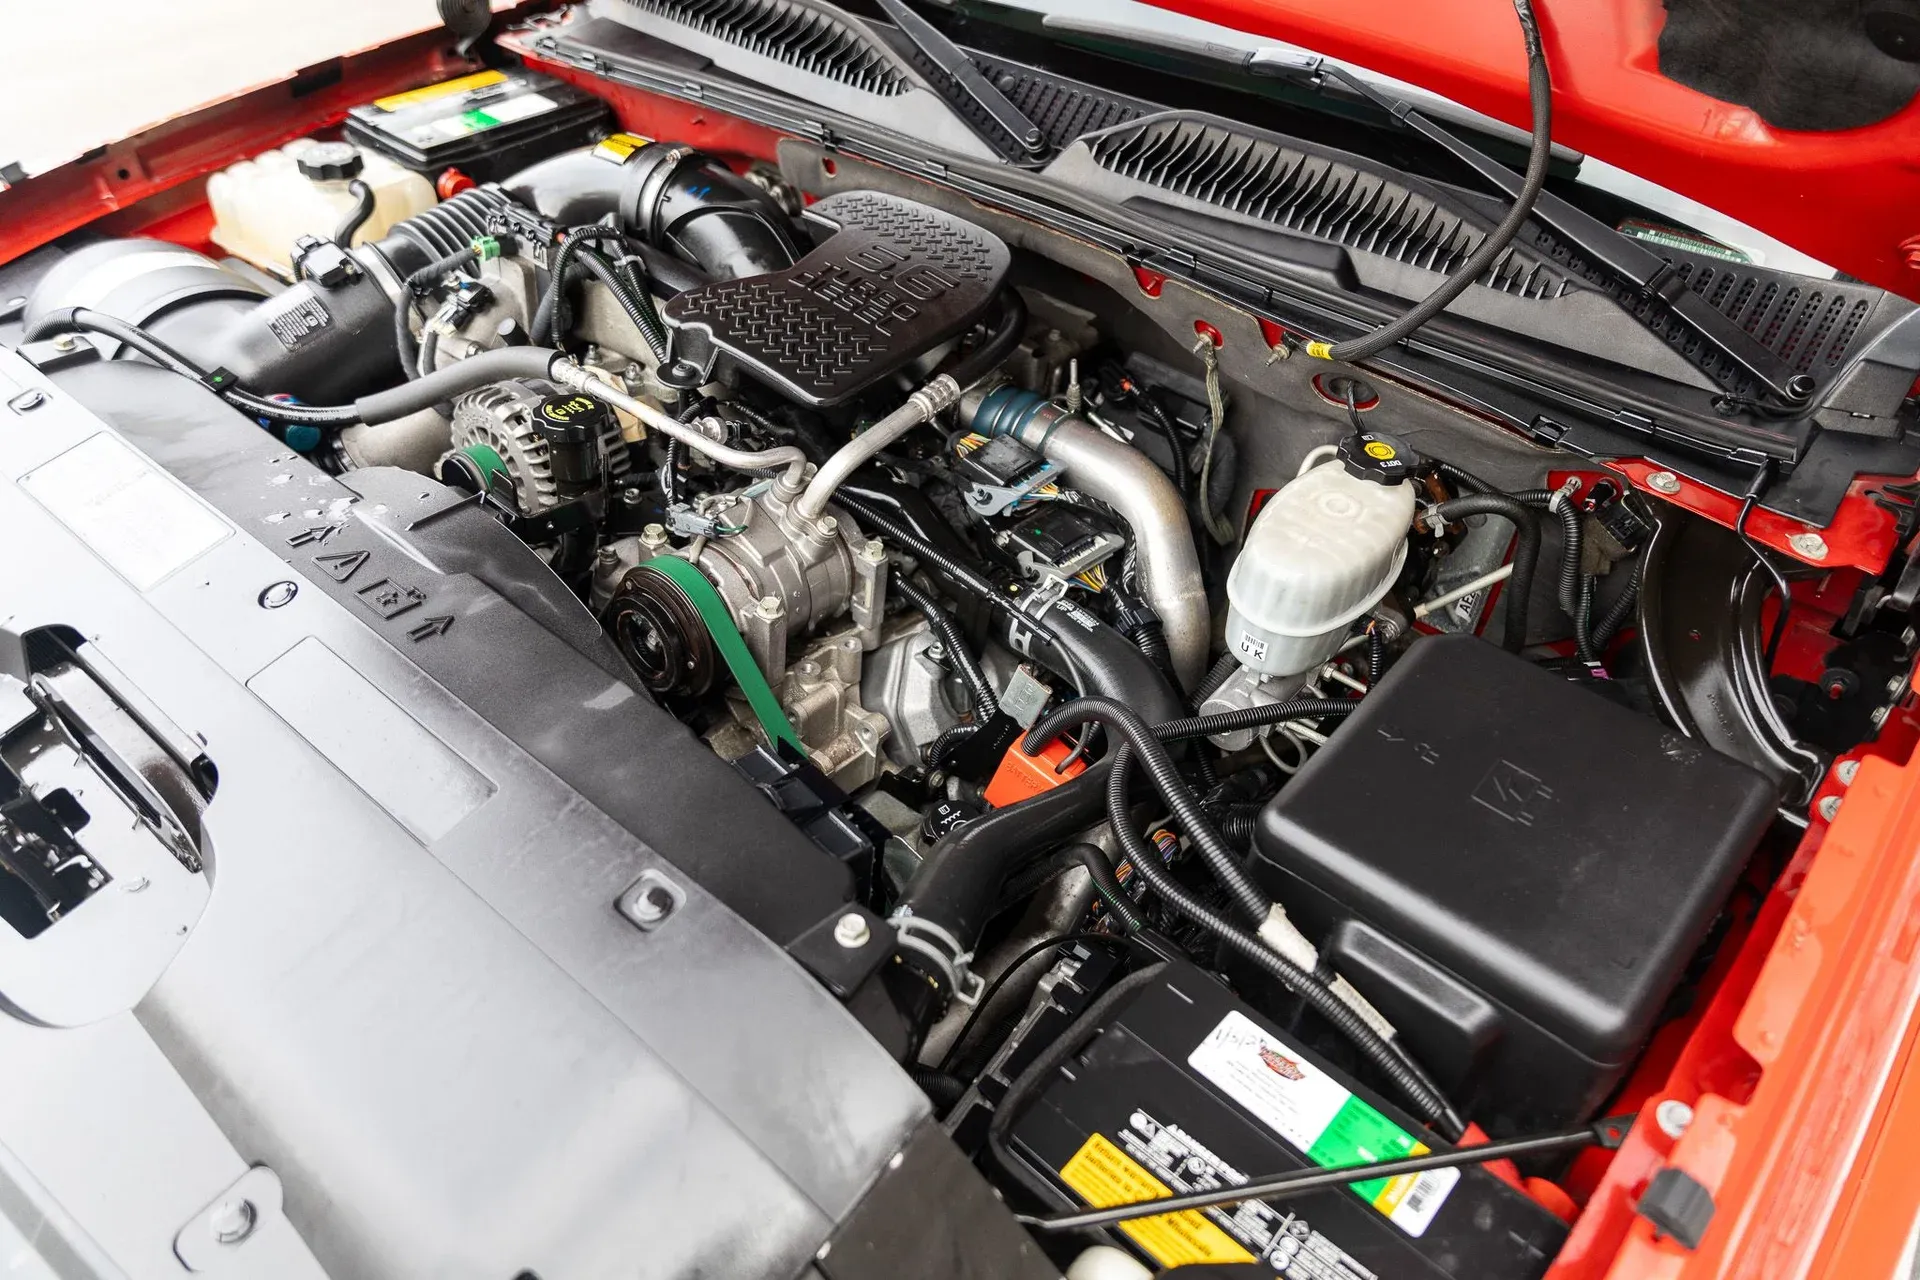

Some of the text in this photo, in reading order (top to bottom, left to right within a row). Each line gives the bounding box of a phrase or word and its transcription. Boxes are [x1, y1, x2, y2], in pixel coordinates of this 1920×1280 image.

[817, 261, 921, 322] TURBO
[845, 241, 961, 300] 6.6
[787, 270, 894, 338] DIESEL
